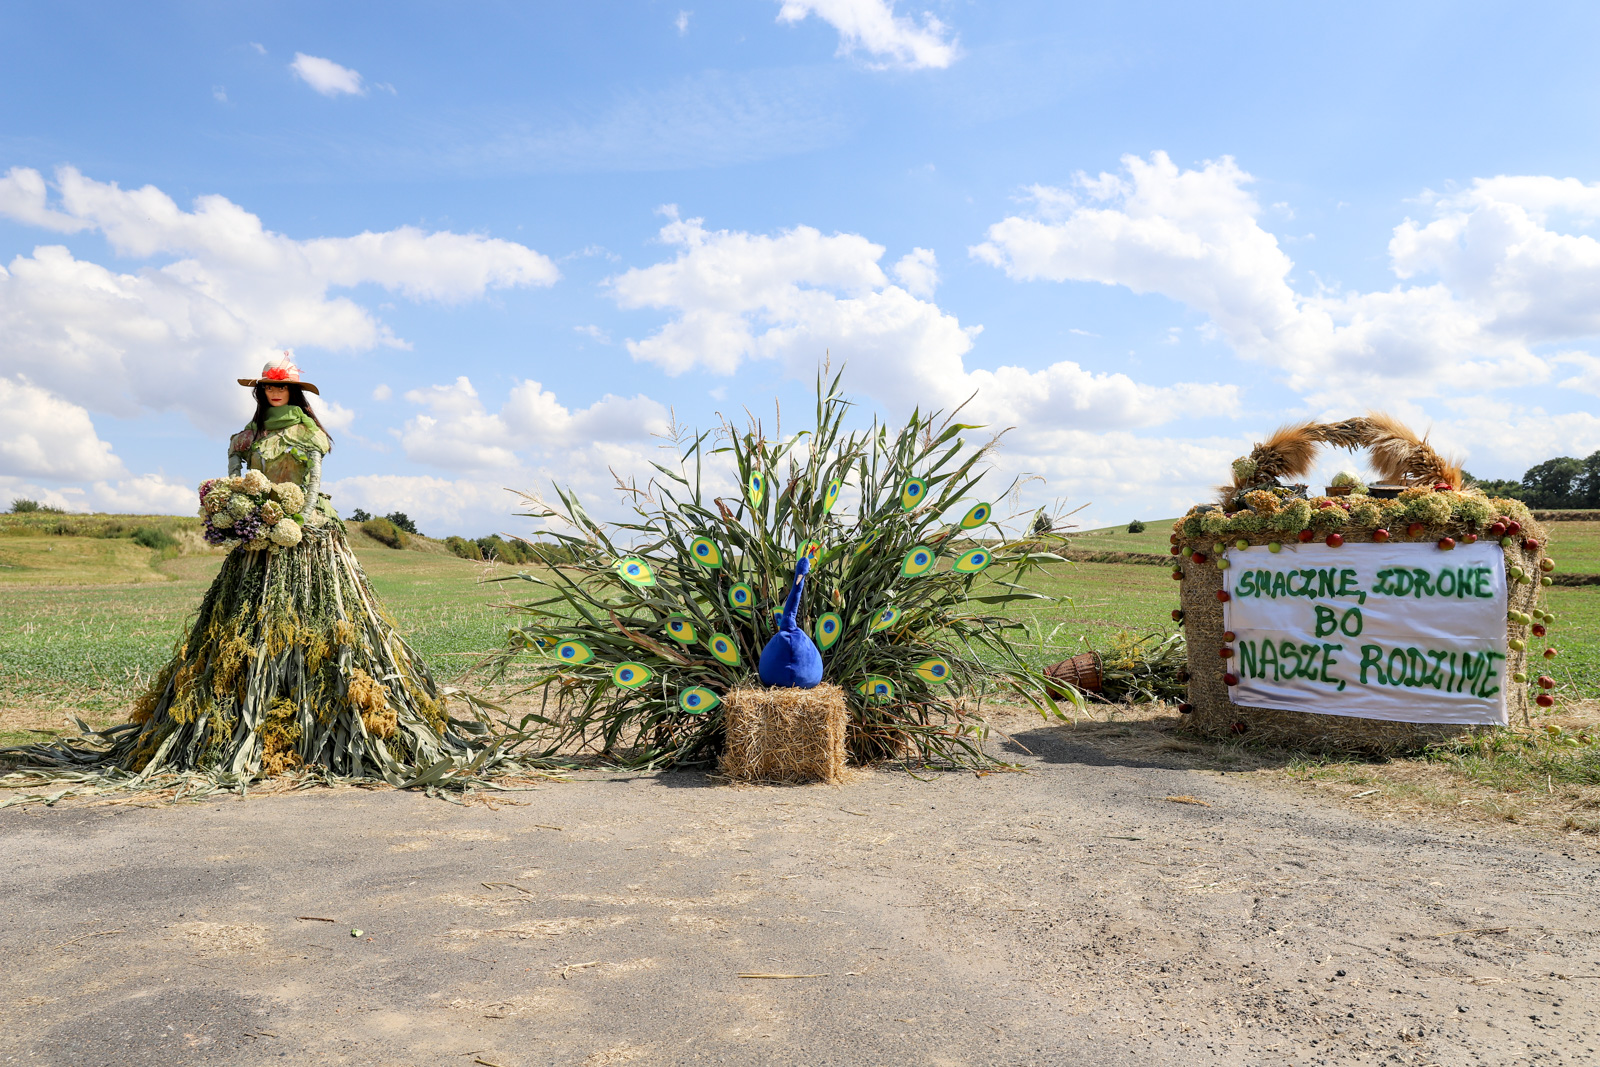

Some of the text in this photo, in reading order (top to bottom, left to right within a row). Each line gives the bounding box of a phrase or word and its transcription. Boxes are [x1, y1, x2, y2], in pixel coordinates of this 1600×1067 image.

[1235, 567, 1367, 604] SMACZNE,
[1315, 605, 1363, 638] BO
[1238, 639, 1506, 698] NASZE, RODZIME
